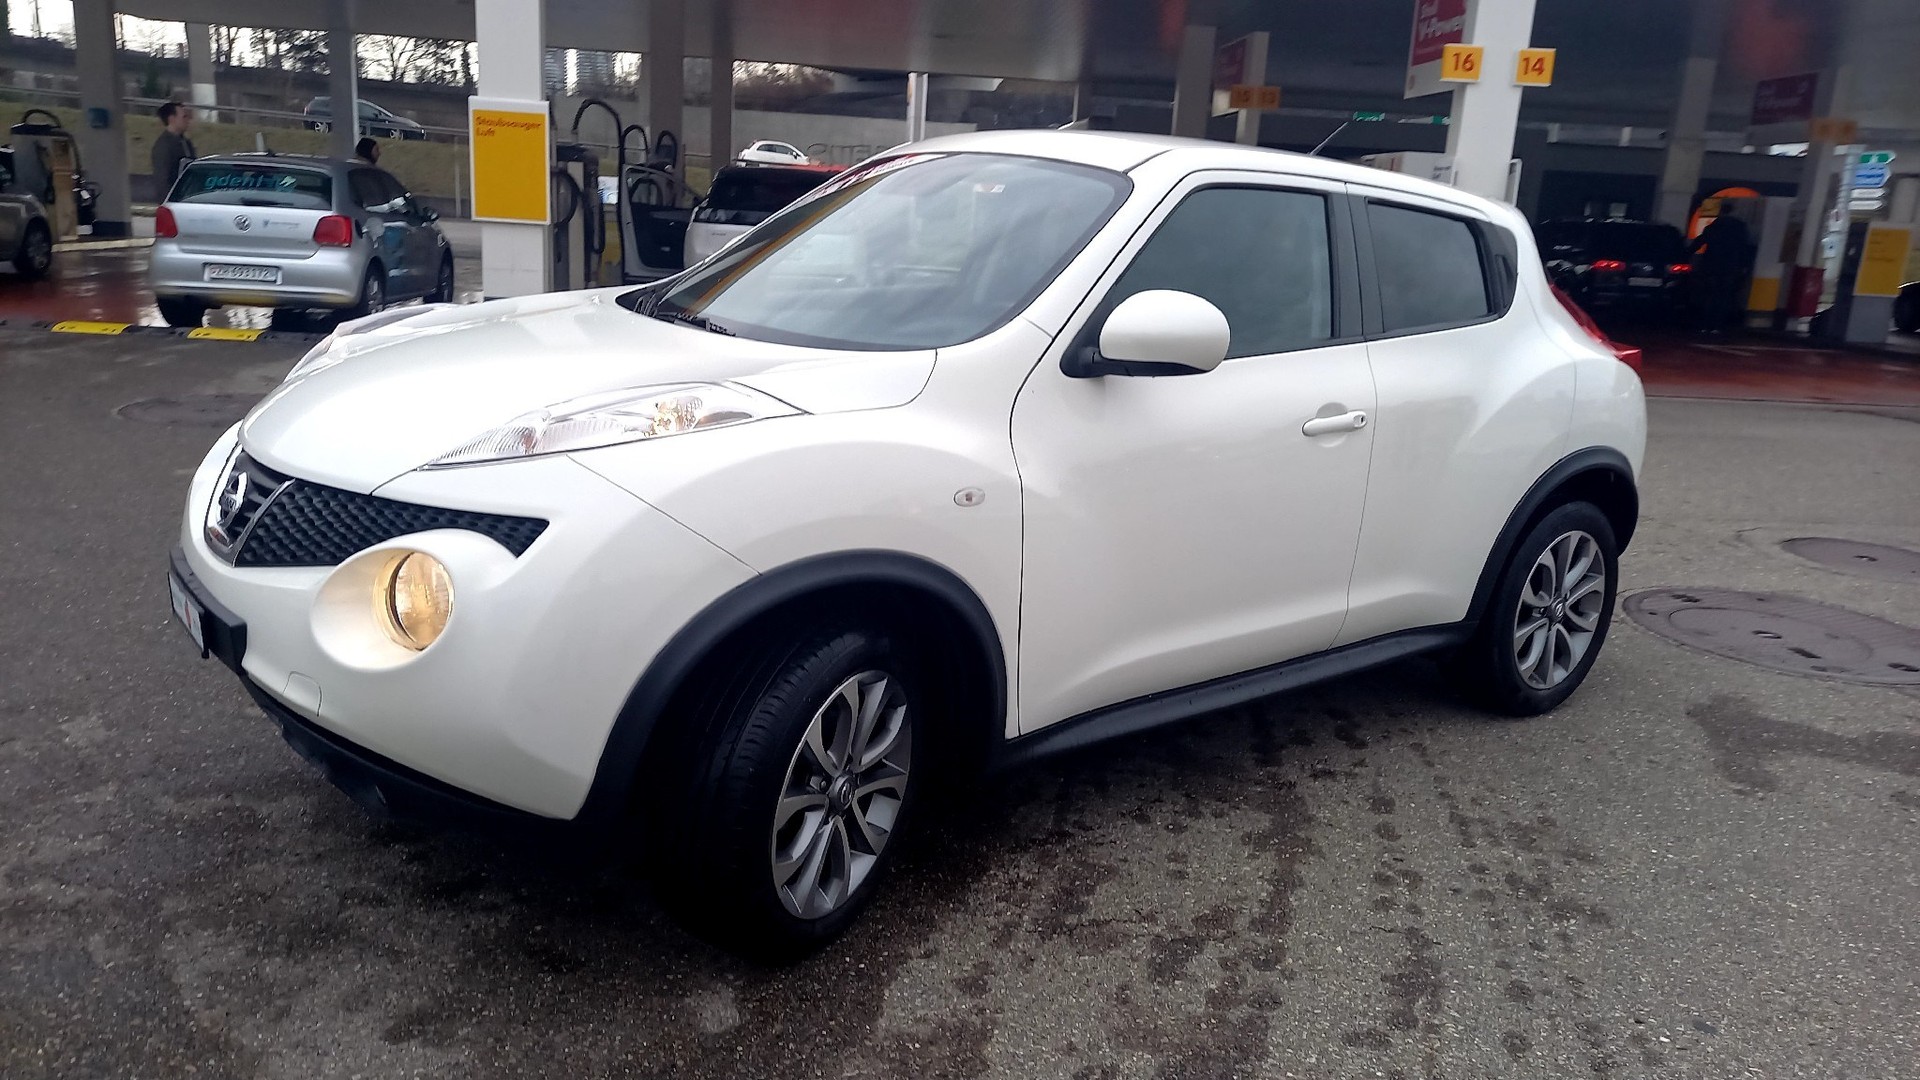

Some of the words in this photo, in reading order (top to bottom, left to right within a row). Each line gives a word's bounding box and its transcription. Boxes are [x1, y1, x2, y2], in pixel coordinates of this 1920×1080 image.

[1453, 52, 1475, 72] 16
[1521, 56, 1546, 76] 14
[475, 115, 542, 131] Staubsauger
